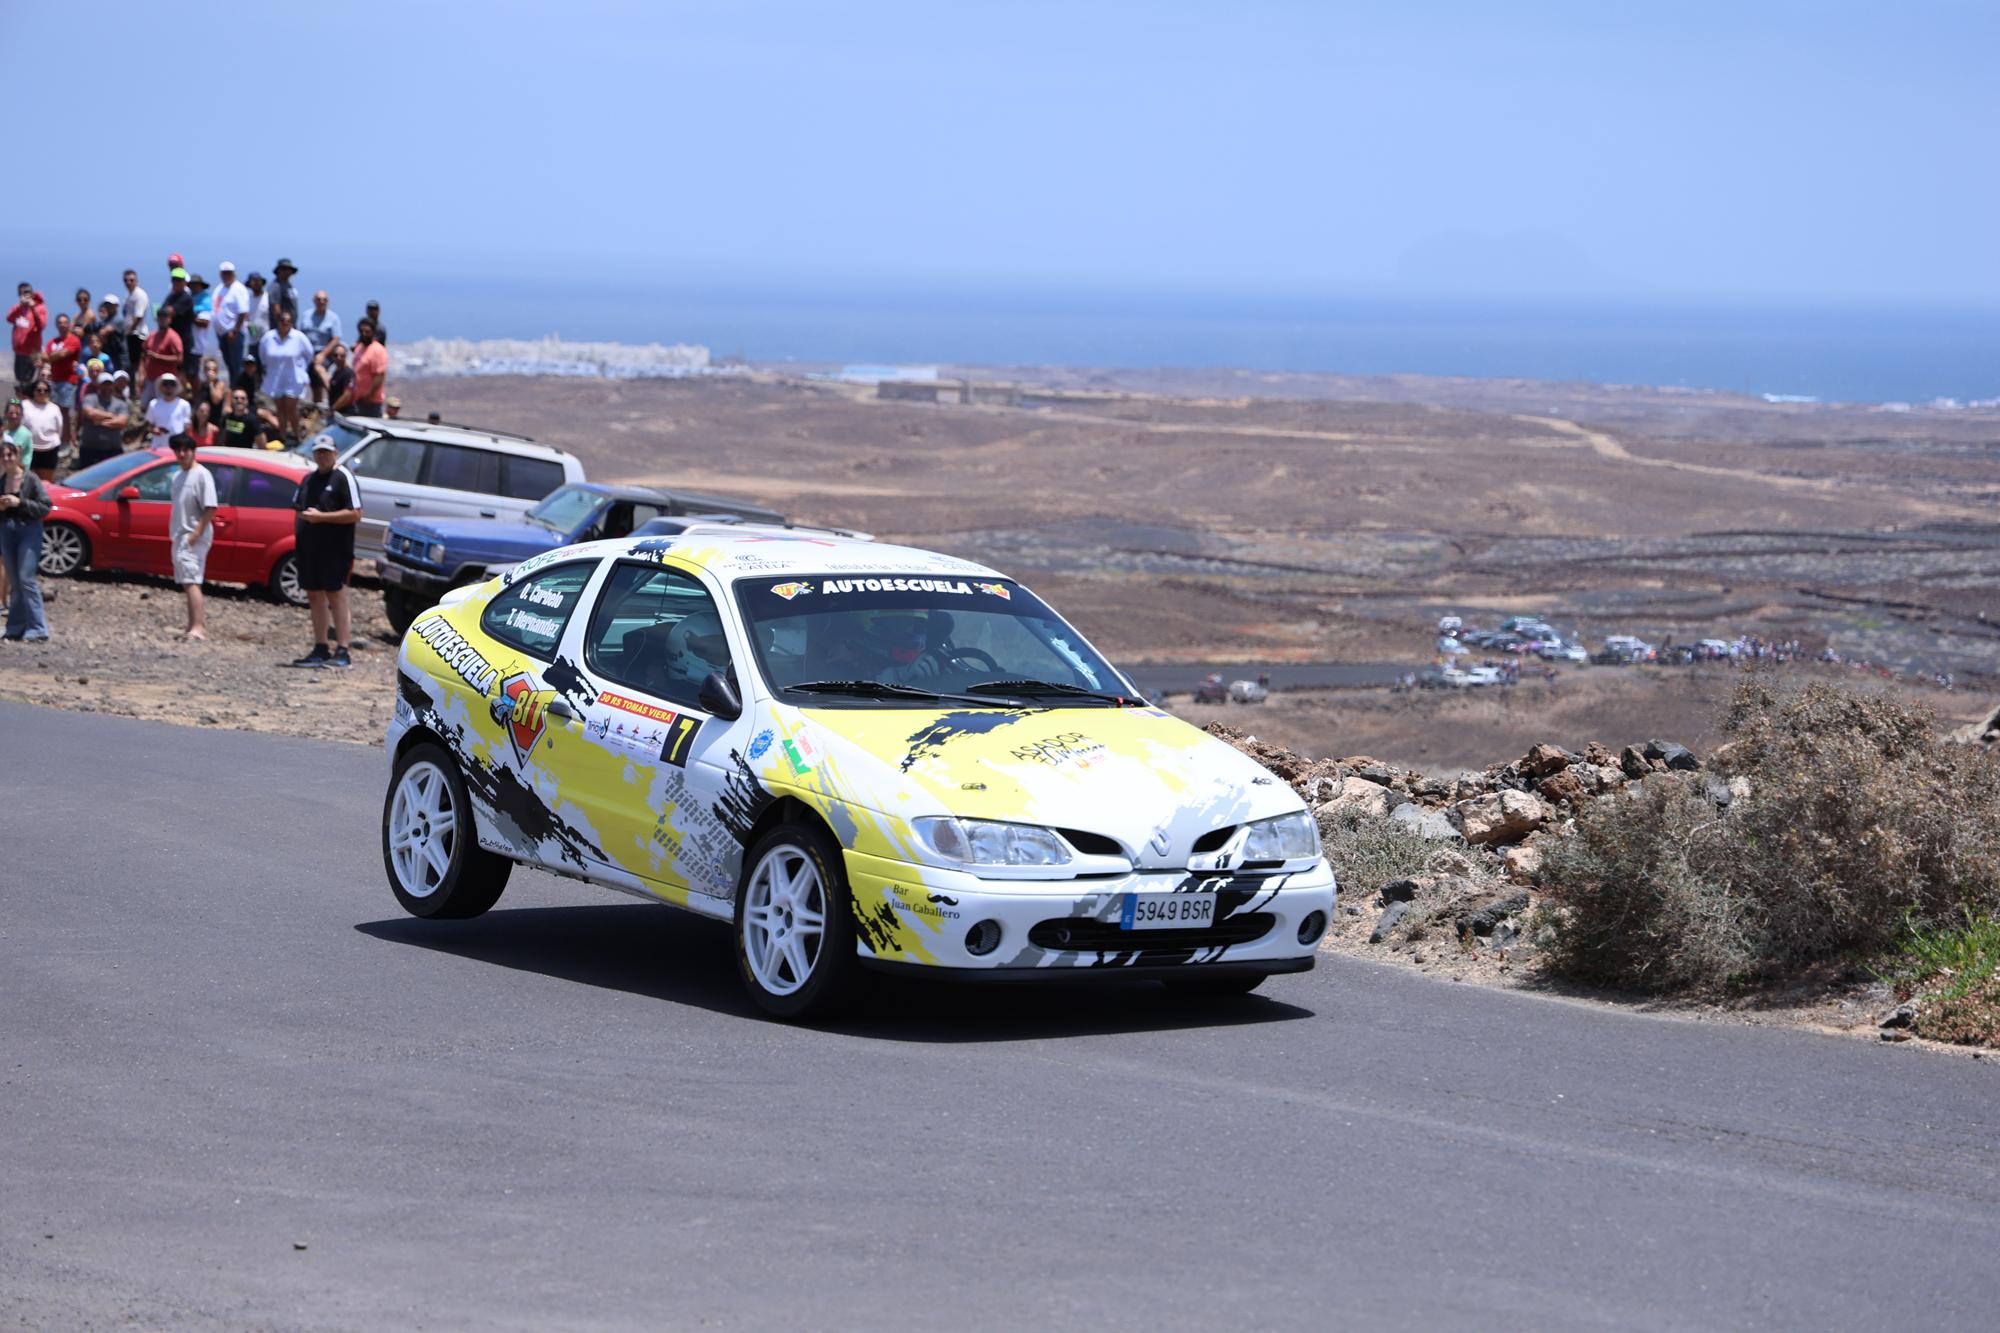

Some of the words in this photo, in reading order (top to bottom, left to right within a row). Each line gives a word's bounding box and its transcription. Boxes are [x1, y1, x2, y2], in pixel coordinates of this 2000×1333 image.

[519, 582, 528, 600] O.
[822, 578, 973, 595] AUTOESCUELA
[506, 608, 517, 626] T.
[513, 609, 560, 639] Hernandez
[412, 615, 498, 698] AUTOESCUELA
[512, 689, 559, 732] BIT
[600, 693, 609, 703] 30
[610, 695, 621, 706] RS
[622, 699, 648, 714] TOMÁS
[648, 708, 672, 721] VIERA
[669, 718, 695, 762] 7
[1010, 732, 1091, 760] ASADOR
[893, 884, 909, 896] Bar
[891, 898, 911, 911] Juan
[913, 903, 960, 920] Caballero
[1136, 901, 1177, 921] 5949
[1181, 900, 1212, 920] BSR
